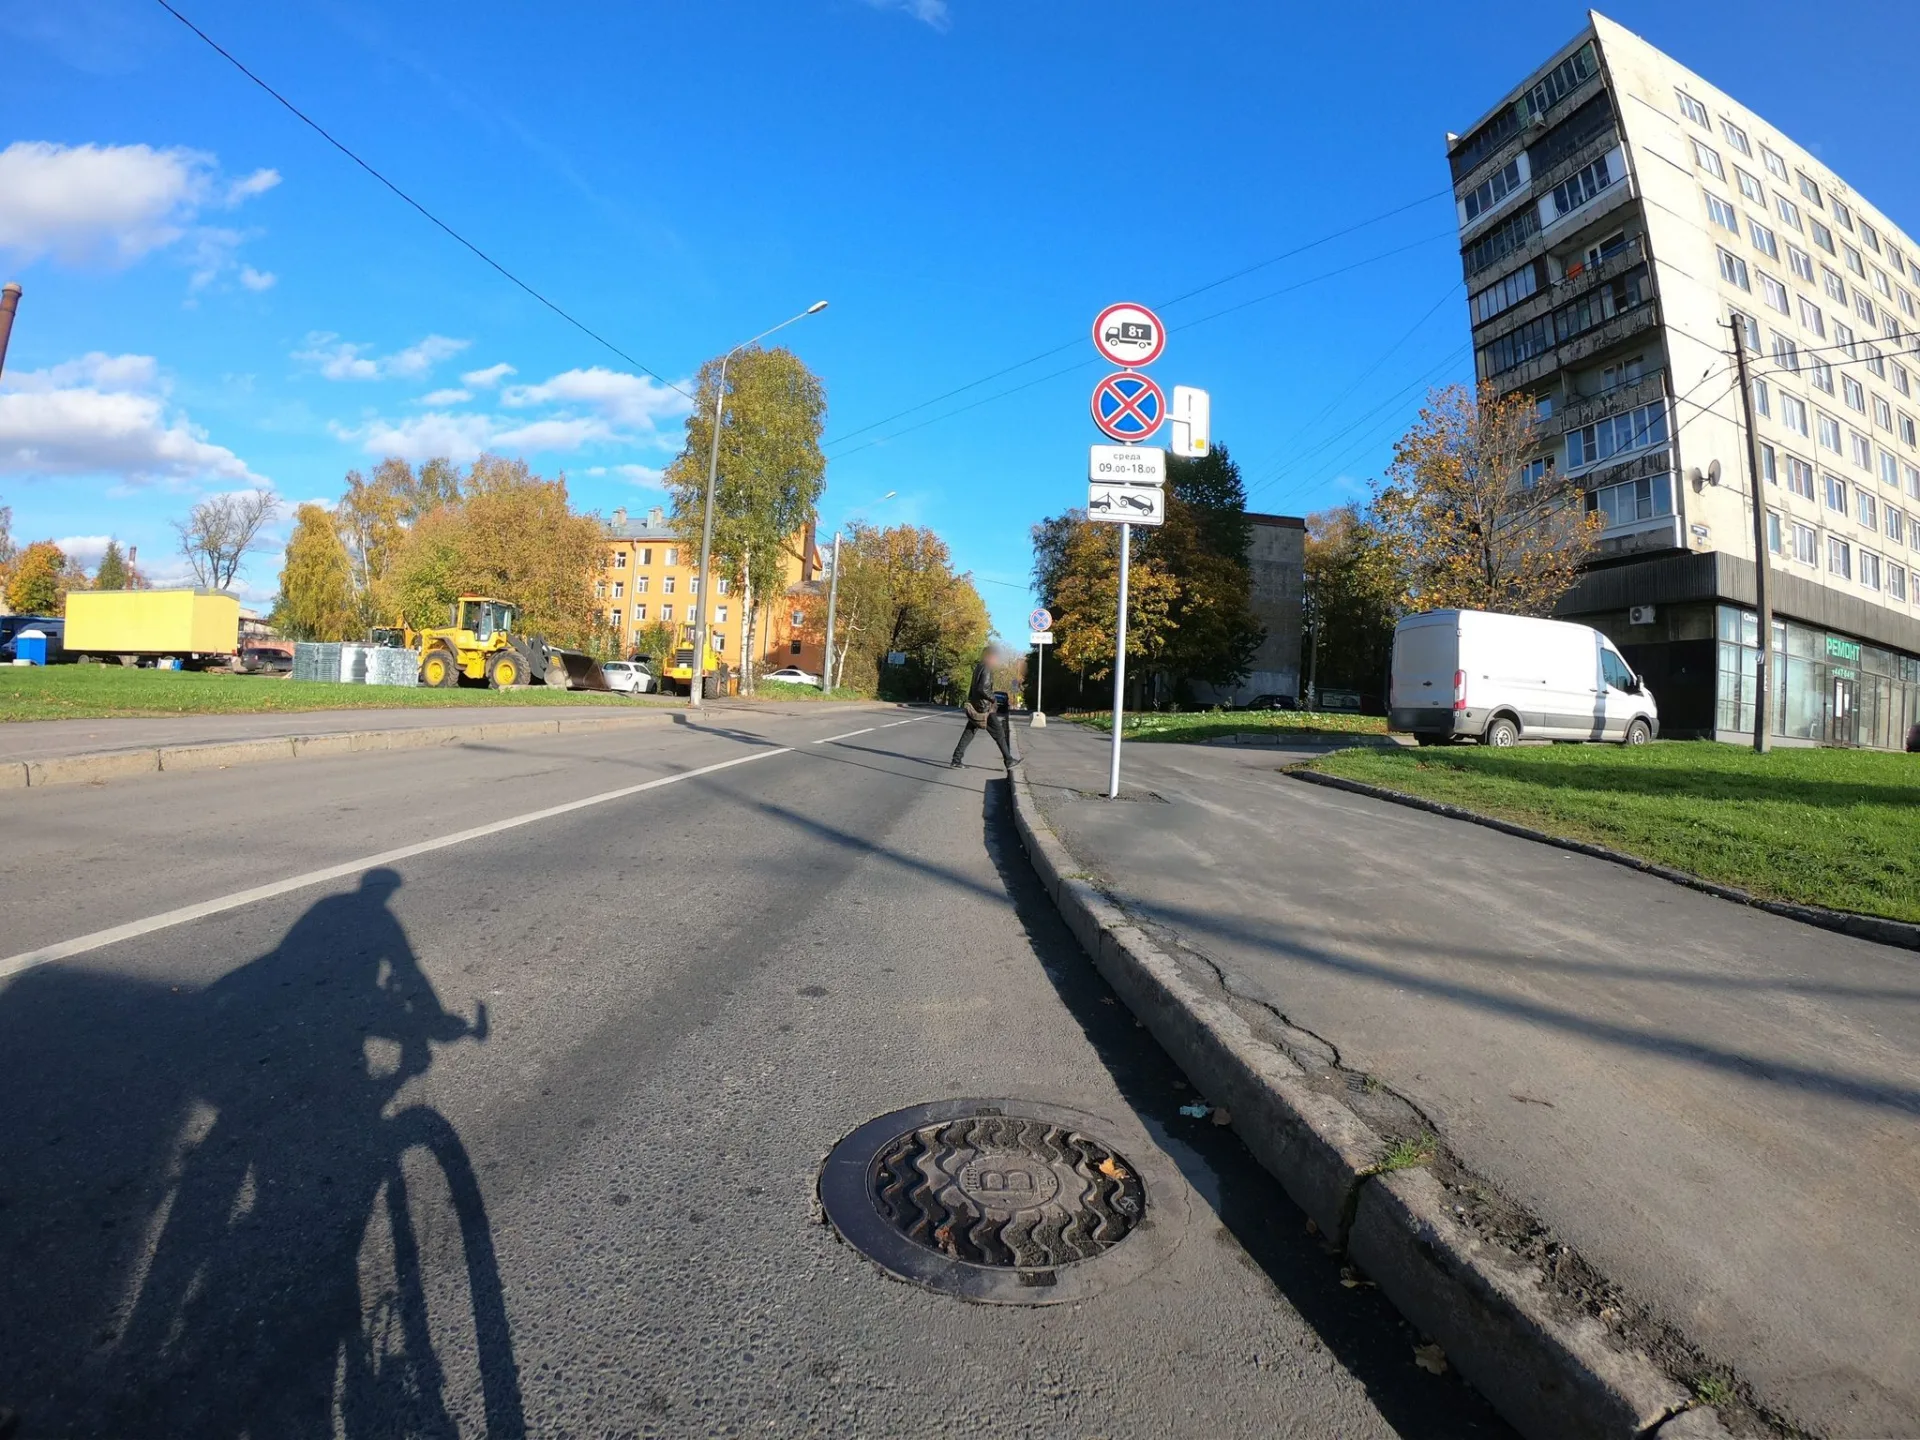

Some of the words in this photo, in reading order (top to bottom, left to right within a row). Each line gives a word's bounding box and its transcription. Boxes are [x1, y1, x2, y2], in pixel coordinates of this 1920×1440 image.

[1113, 453, 1141, 461] среда
[1099, 463, 1156, 474] 09.00-18.00
[1826, 636, 1860, 662] РЕМОНТ
